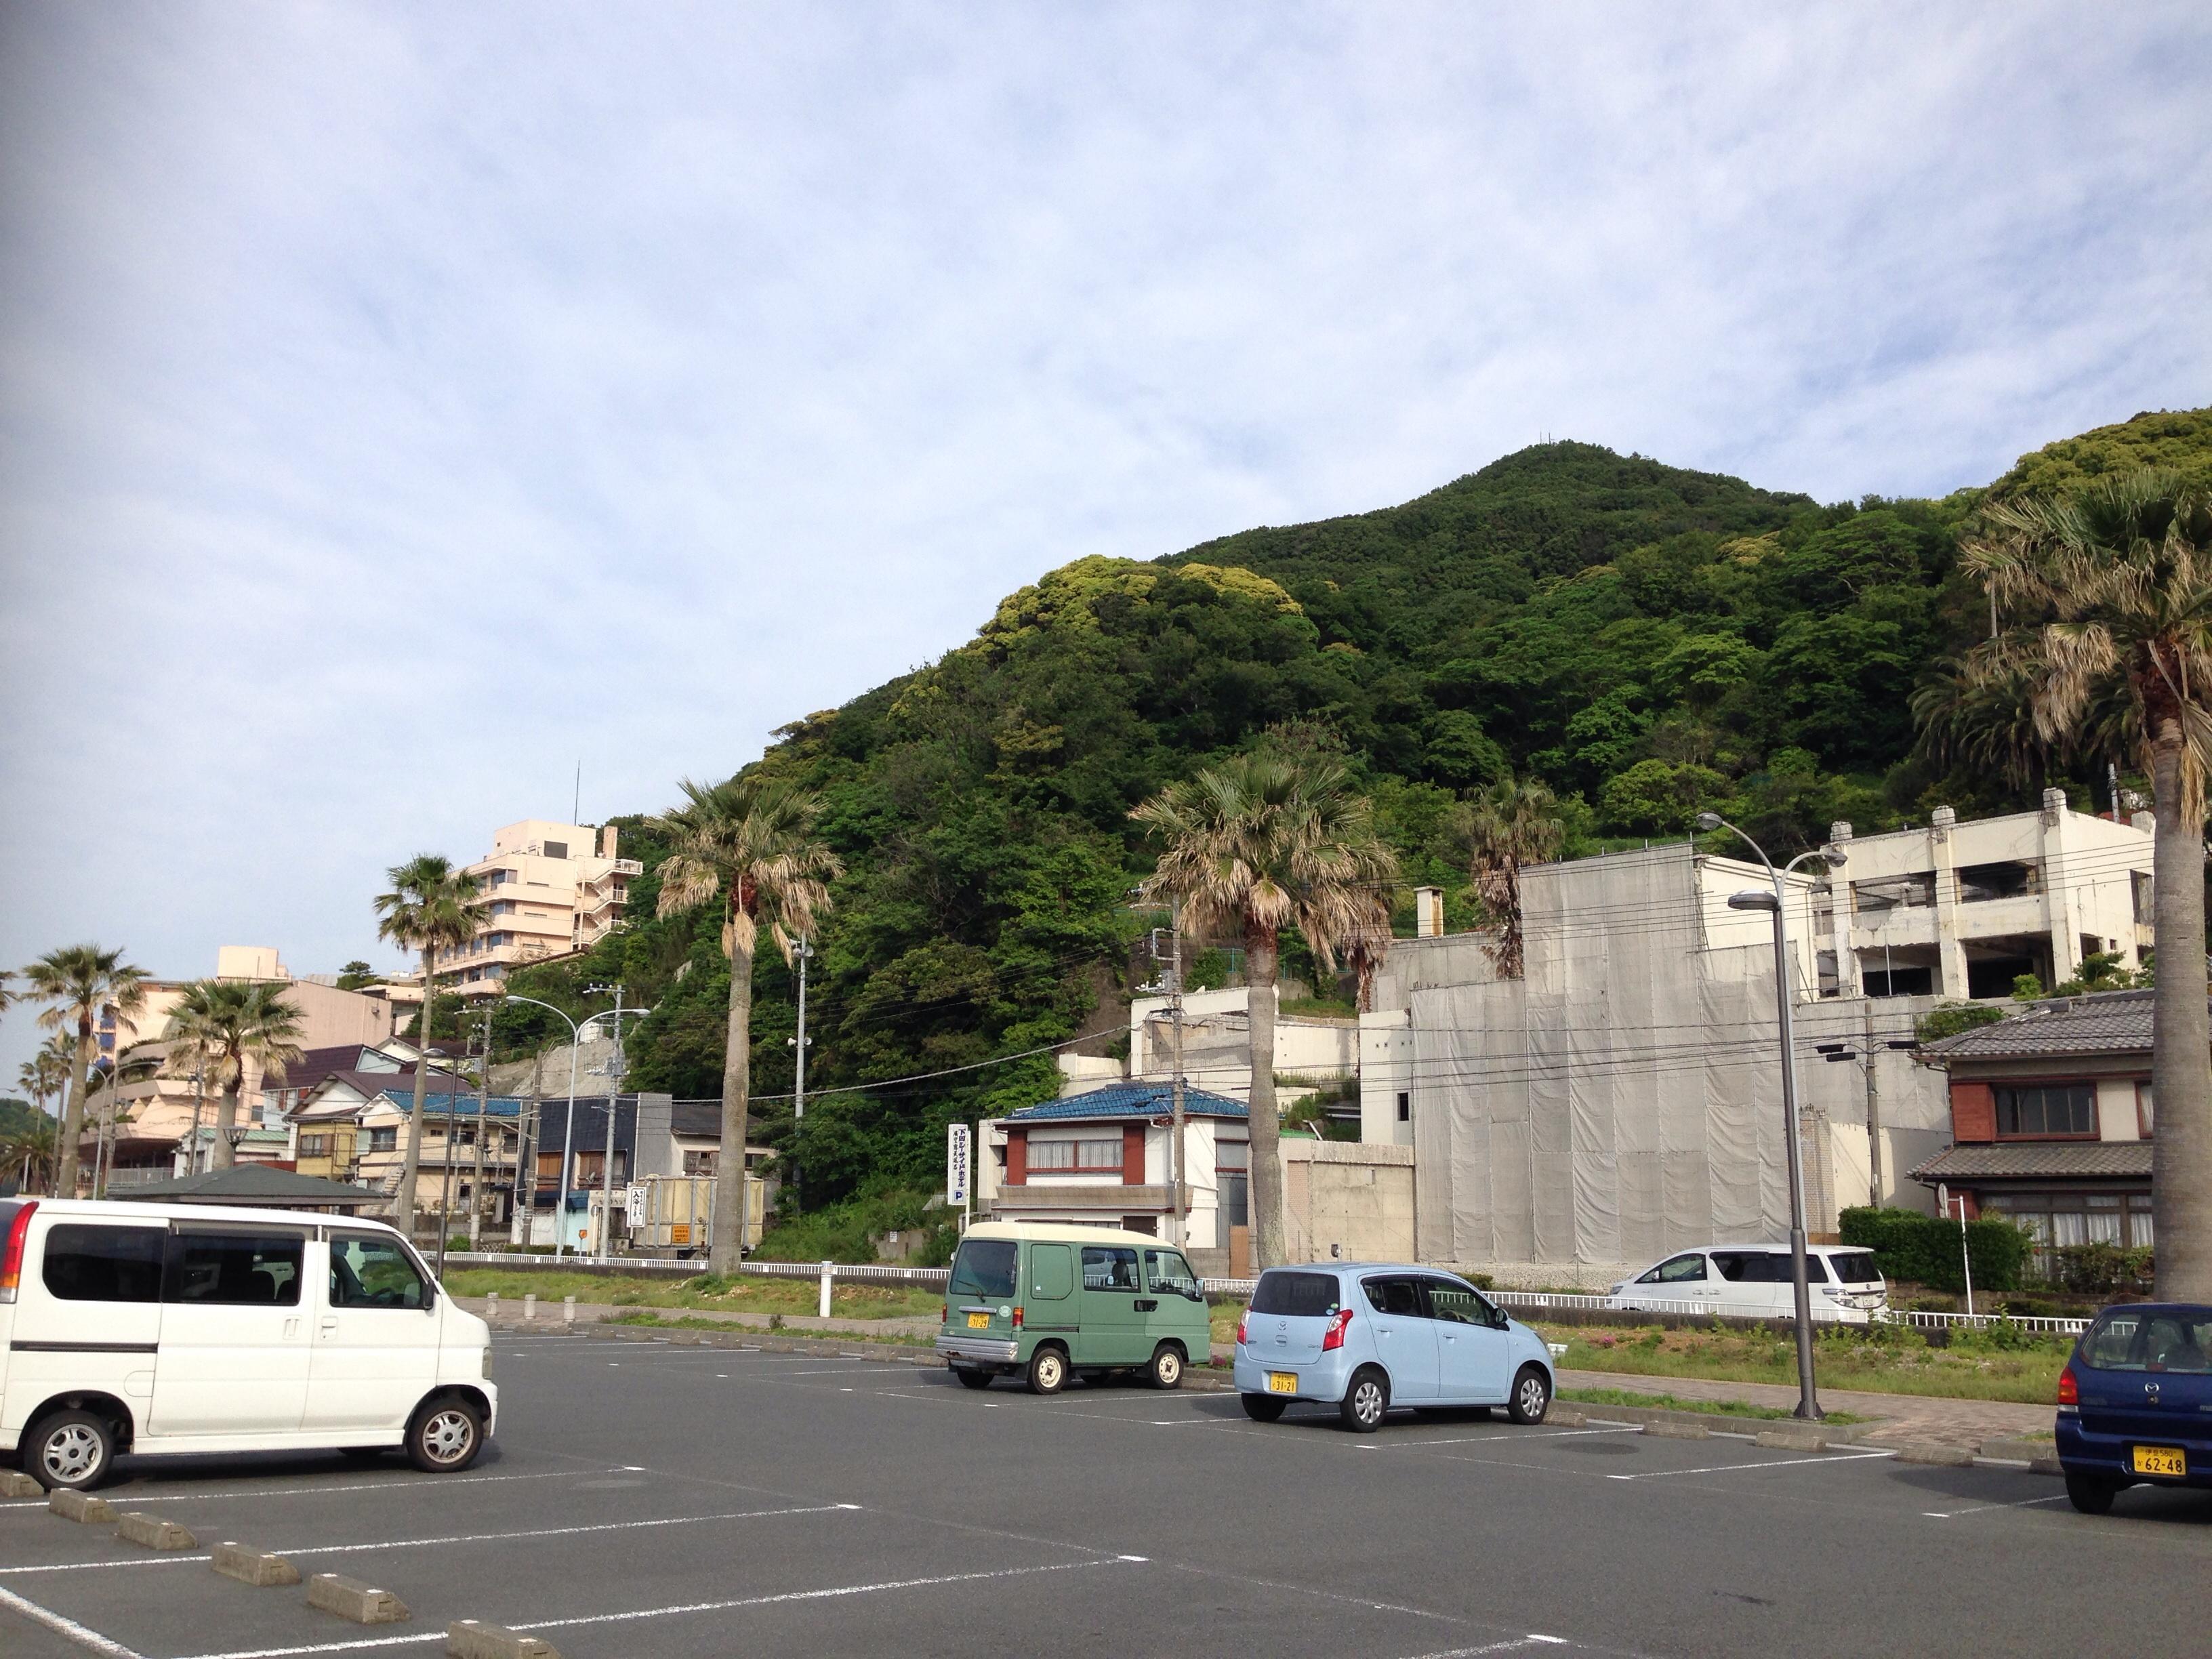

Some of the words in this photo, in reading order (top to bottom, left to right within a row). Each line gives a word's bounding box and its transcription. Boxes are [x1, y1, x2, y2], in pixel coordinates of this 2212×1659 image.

[956, 1191, 962, 1200] P
[1276, 1381, 1294, 1391] 31-21
[2145, 1458, 2182, 1473] 62-48
